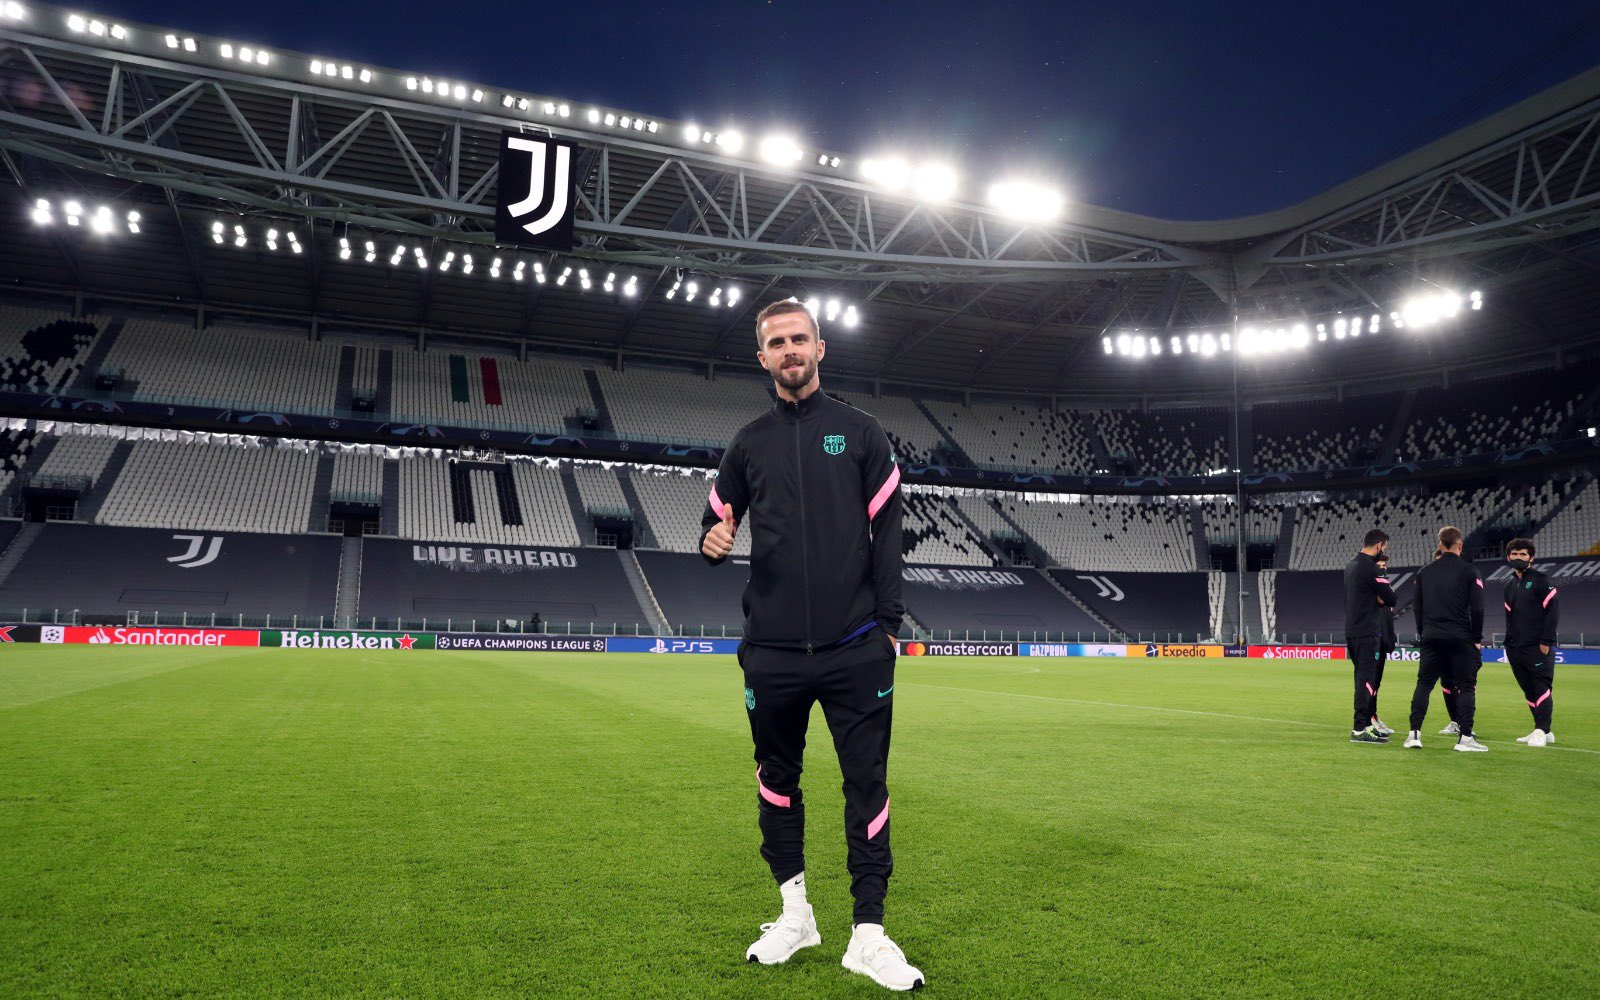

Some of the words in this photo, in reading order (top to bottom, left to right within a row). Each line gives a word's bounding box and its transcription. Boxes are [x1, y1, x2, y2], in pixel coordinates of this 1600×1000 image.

[413, 545, 475, 563] LIVE
[483, 548, 577, 568] AHEAD
[947, 568, 1025, 586] AHEAD
[114, 628, 227, 646] Santander
[280, 630, 395, 649] Heineken
[452, 638, 482, 648] UEFA
[484, 639, 549, 649] CHAMPIONS
[551, 640, 591, 650] LEAGUE
[672, 641, 713, 653] PS5
[929, 643, 1013, 656] mastercard
[1029, 644, 1068, 657] GAZPROM
[1162, 645, 1206, 657] Expedia
[1275, 646, 1332, 659] Santander
